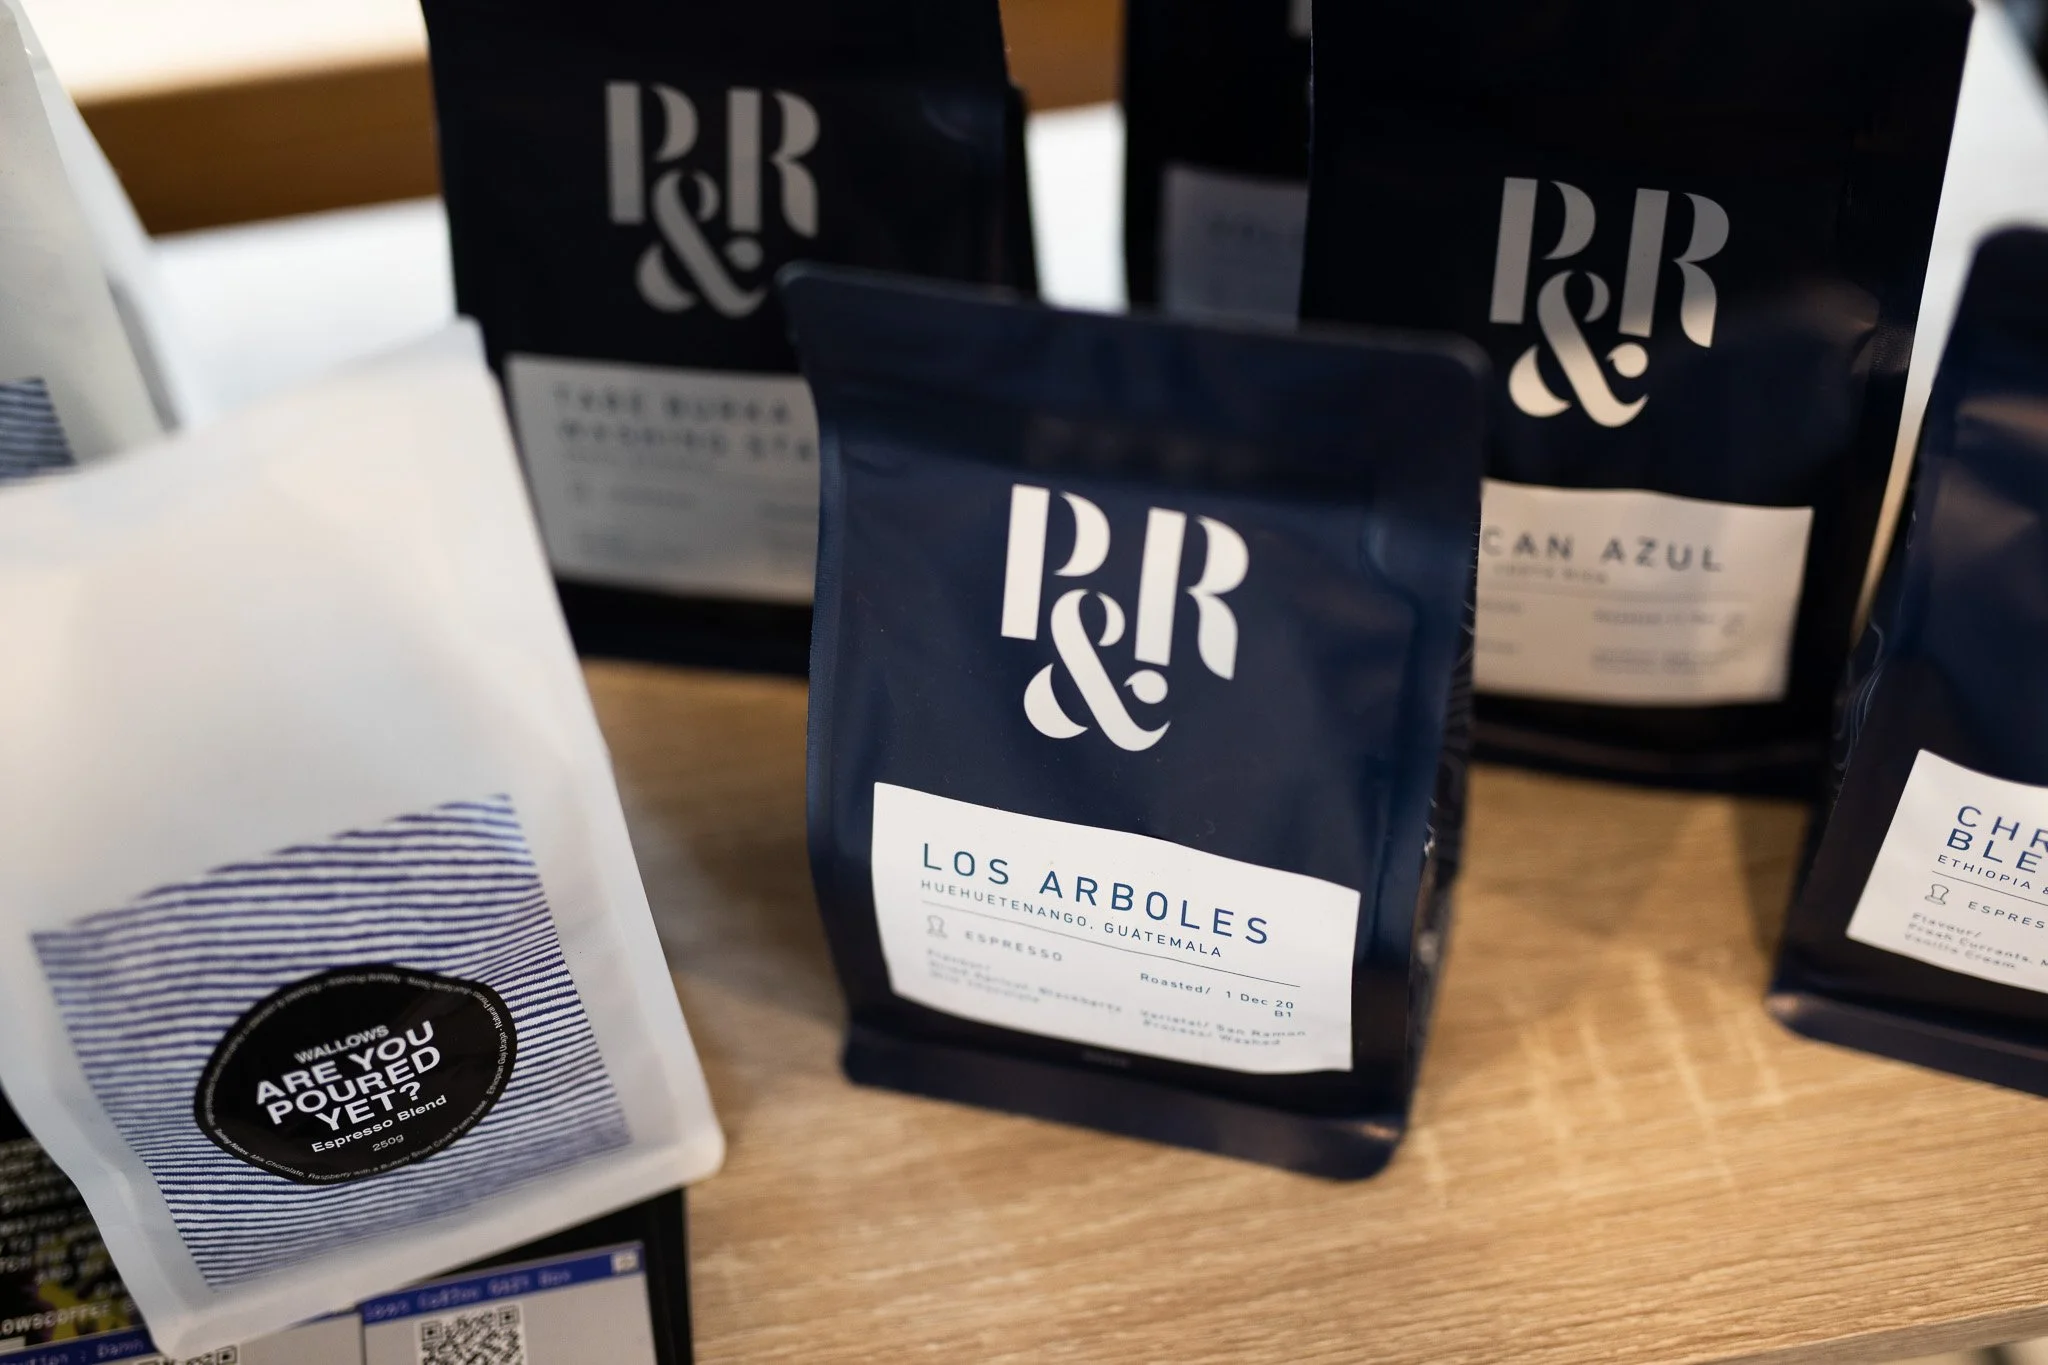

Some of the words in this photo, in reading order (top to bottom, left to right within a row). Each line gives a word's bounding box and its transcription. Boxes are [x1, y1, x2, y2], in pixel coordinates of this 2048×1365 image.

[1601, 535, 1723, 572] AZUL
[1957, 805, 2048, 853] CHR
[1947, 828, 2043, 874] BLE
[1937, 854, 2031, 890] ETHIOPIA
[922, 842, 1011, 886] LOS
[1039, 870, 1269, 945] ARBOLES
[1968, 901, 2045, 929] ESPRES
[965, 930, 1063, 962] ESPRESSO
[1104, 921, 1223, 958] GUATEMALA
[1139, 972, 1211, 996] Roasted/
[1225, 990, 1232, 999] 1
[1240, 993, 1269, 1007] Dec
[1275, 999, 1294, 1010] 20
[1274, 1010, 1292, 1018] B1
[256, 1060, 343, 1106] ARE
[348, 1019, 435, 1073] YOU
[295, 1024, 390, 1064] WALLOWS
[264, 1045, 442, 1126] POURED
[311, 1118, 394, 1154] Espresso
[396, 1093, 448, 1123] Blend
[314, 1080, 422, 1132] YET?
[371, 1132, 405, 1153] 250g
